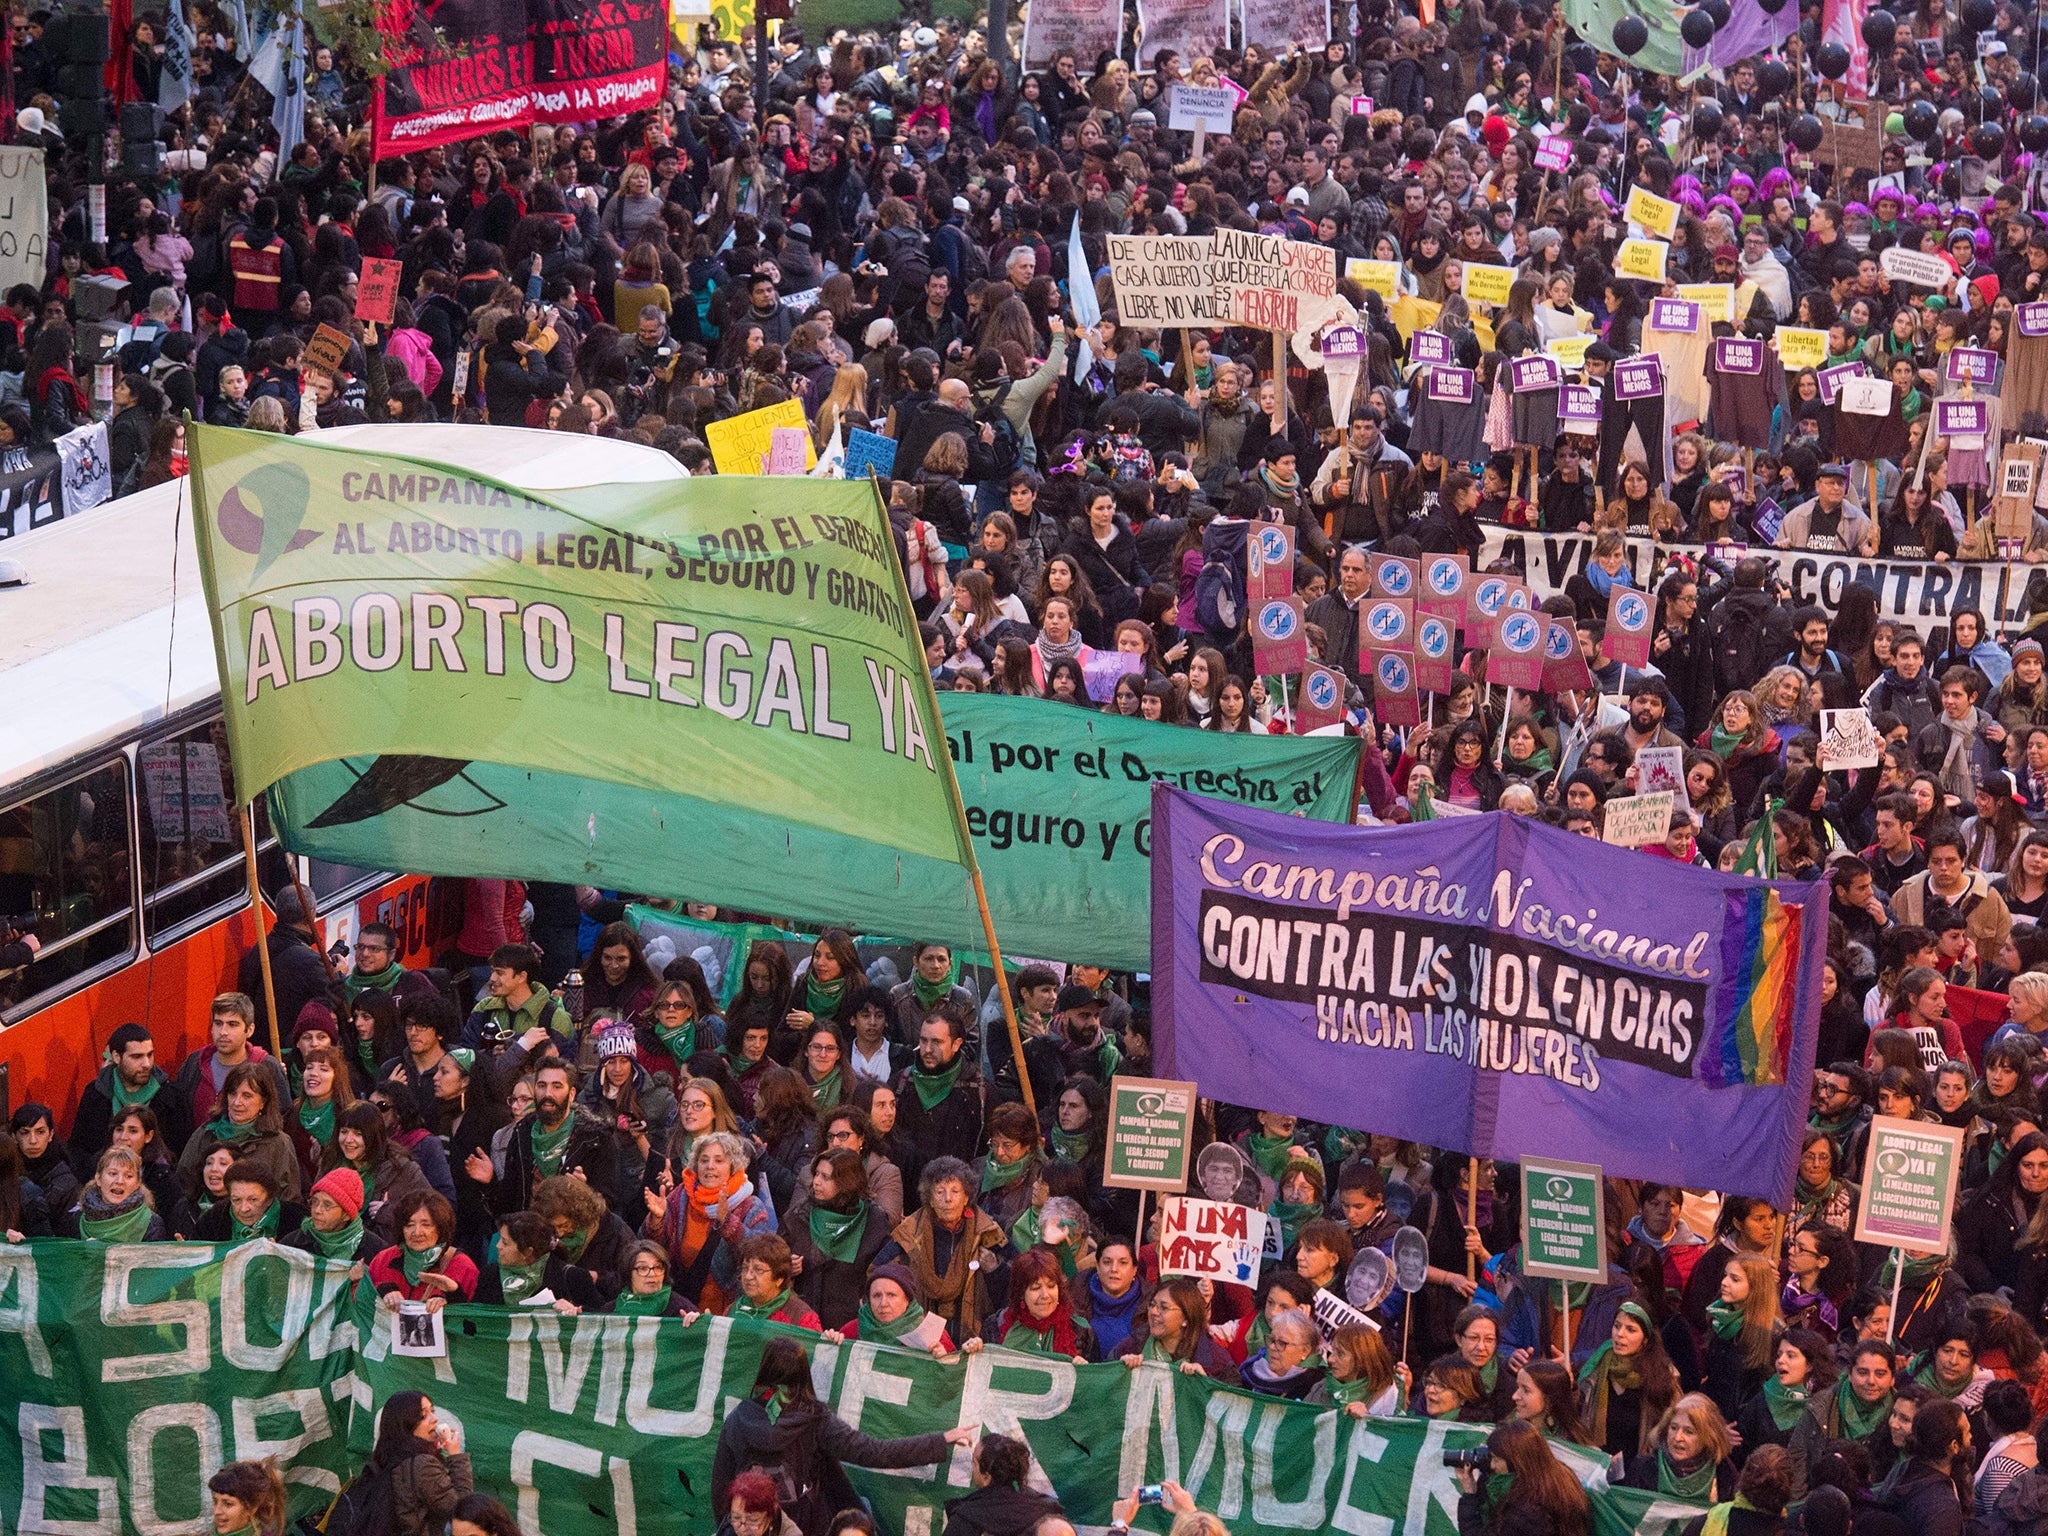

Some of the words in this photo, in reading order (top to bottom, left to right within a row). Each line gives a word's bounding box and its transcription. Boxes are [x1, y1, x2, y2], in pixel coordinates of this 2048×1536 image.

[575, 87, 594, 107] LA
[1177, 87, 1190, 96] NO
[1191, 88, 1199, 96] TE
[1201, 88, 1229, 99] CALLES
[1179, 97, 1225, 108] DENUNCIA
[1640, 197, 1663, 212] Aborto
[1640, 207, 1659, 220] Legal
[1111, 240, 1136, 261] DE
[1143, 240, 1201, 262] CAMINO
[1631, 245, 1651, 255] Aborto
[1282, 241, 1334, 274] SANGRE
[1631, 255, 1650, 265] Legal
[1891, 265, 1912, 277] Salud
[1898, 259, 1934, 273] problema
[1115, 265, 1150, 287] CASA
[1154, 265, 1200, 287] QUIERO
[1483, 272, 1504, 283] Cuerpo
[1290, 269, 1335, 300] CORRER
[1469, 279, 1478, 288] Mis
[1479, 280, 1508, 291] Derechos
[1215, 286, 1231, 302] ES
[1123, 295, 1164, 323] LIBRE,
[1164, 295, 1185, 319] NO
[1214, 304, 1230, 319] LA
[1662, 304, 1672, 315] NI
[1672, 305, 1689, 317] UNA
[1660, 314, 1689, 326] MENOS
[1330, 332, 1339, 343] NI
[1340, 332, 1357, 343] UNA
[1420, 335, 1428, 347] NI
[1428, 336, 1443, 349] UNA
[1786, 334, 1818, 346] Libertad
[1330, 342, 1358, 353] MENOS
[1419, 346, 1443, 359] MENOS
[1725, 344, 1736, 356] NI
[1736, 345, 1753, 357] UNA
[1725, 355, 1754, 367] MENOS
[1958, 354, 1969, 366] NI
[1970, 355, 1987, 367] UNA
[1520, 363, 1530, 376] NI
[1530, 360, 1548, 374] UNA
[1438, 373, 1446, 385] NI
[1446, 373, 1463, 385] UNA
[1521, 371, 1549, 385] MENOS
[1622, 370, 1633, 382] NI
[1633, 369, 1650, 381] UNA
[1437, 383, 1463, 396] MENOS
[1622, 380, 1652, 393] MENOS
[1568, 391, 1578, 403] NI
[1567, 401, 1597, 413] MENOS
[1948, 406, 1958, 417] NI
[1958, 406, 1977, 418] UNA
[743, 404, 797, 432] CLIENTE
[1947, 416, 1977, 429] MENOS
[2008, 464, 2017, 477] NI
[341, 470, 512, 508] CAMPAÑA
[2006, 480, 2028, 493] MENOS
[699, 523, 765, 564] POR
[780, 514, 812, 550] EL
[333, 522, 376, 556] AL
[386, 521, 523, 564] ABORTO
[537, 533, 653, 580] LEGAL,
[667, 552, 796, 595] SEGURO
[805, 563, 819, 600] Y
[246, 591, 576, 705] ABORTO
[603, 614, 852, 742] LEGAL
[864, 655, 936, 774] YA
[990, 742, 1060, 774] por
[1074, 747, 1110, 780] el
[1293, 772, 1323, 806] al
[1637, 810, 1666, 822] REDES
[966, 806, 1086, 850] eguro
[1100, 824, 1123, 861] y
[1628, 822, 1657, 836] TRATA
[1200, 832, 1471, 920] Campaña
[1478, 868, 1712, 979] Nacional
[1204, 905, 1376, 995] CONTRA
[1395, 930, 1458, 1006] LAS
[1469, 942, 1694, 1064] VIOLENCIAS
[1317, 993, 1414, 1052] HACIA
[1424, 1005, 1466, 1060] LAS
[1468, 1018, 1603, 1093] MUJERES
[1119, 1115, 1150, 1128] CAMPAÑA
[1150, 1118, 1180, 1130] NACIONAL
[1115, 1132, 1123, 1143] EL
[1123, 1134, 1150, 1145] DERECHO
[1150, 1136, 1158, 1146] AL
[1158, 1138, 1182, 1148] ABORTO
[1882, 1135, 1916, 1151] ABORTO
[1916, 1141, 1945, 1157] LEGAL
[1126, 1146, 1144, 1157] LEGAL
[1127, 1159, 1133, 1168] Y
[1133, 1159, 1165, 1171] GRATUITO
[1910, 1158, 1925, 1176] YA
[1882, 1178, 1891, 1189] LA
[1890, 1180, 1914, 1192] MUJER
[1913, 1183, 1936, 1196] DECIDE
[1531, 1198, 1560, 1212] CAMPAÑA
[1560, 1203, 1590, 1216] NACIONAL
[1873, 1191, 1882, 1201] LA
[1882, 1192, 1914, 1206] SOCIEDAD
[1913, 1197, 1940, 1211] RESPETA
[1166, 1197, 1188, 1233] NI
[1196, 1206, 1248, 1240] UNA
[1871, 1204, 1880, 1214] EL
[1879, 1205, 1904, 1219] ESTADO
[1903, 1210, 1939, 1225] GARANTIZA
[1529, 1217, 1537, 1228] EL
[1537, 1218, 1563, 1231] DERECHO
[1563, 1222, 1571, 1232] AL
[1571, 1223, 1595, 1236] ABORTO
[1541, 1232, 1558, 1244] LEGAL
[1162, 1235, 1222, 1273] MENOS
[1543, 1245, 1549, 1255] Y
[1549, 1246, 1581, 1259] GRATUITO
[1316, 1297, 1338, 1319] NI
